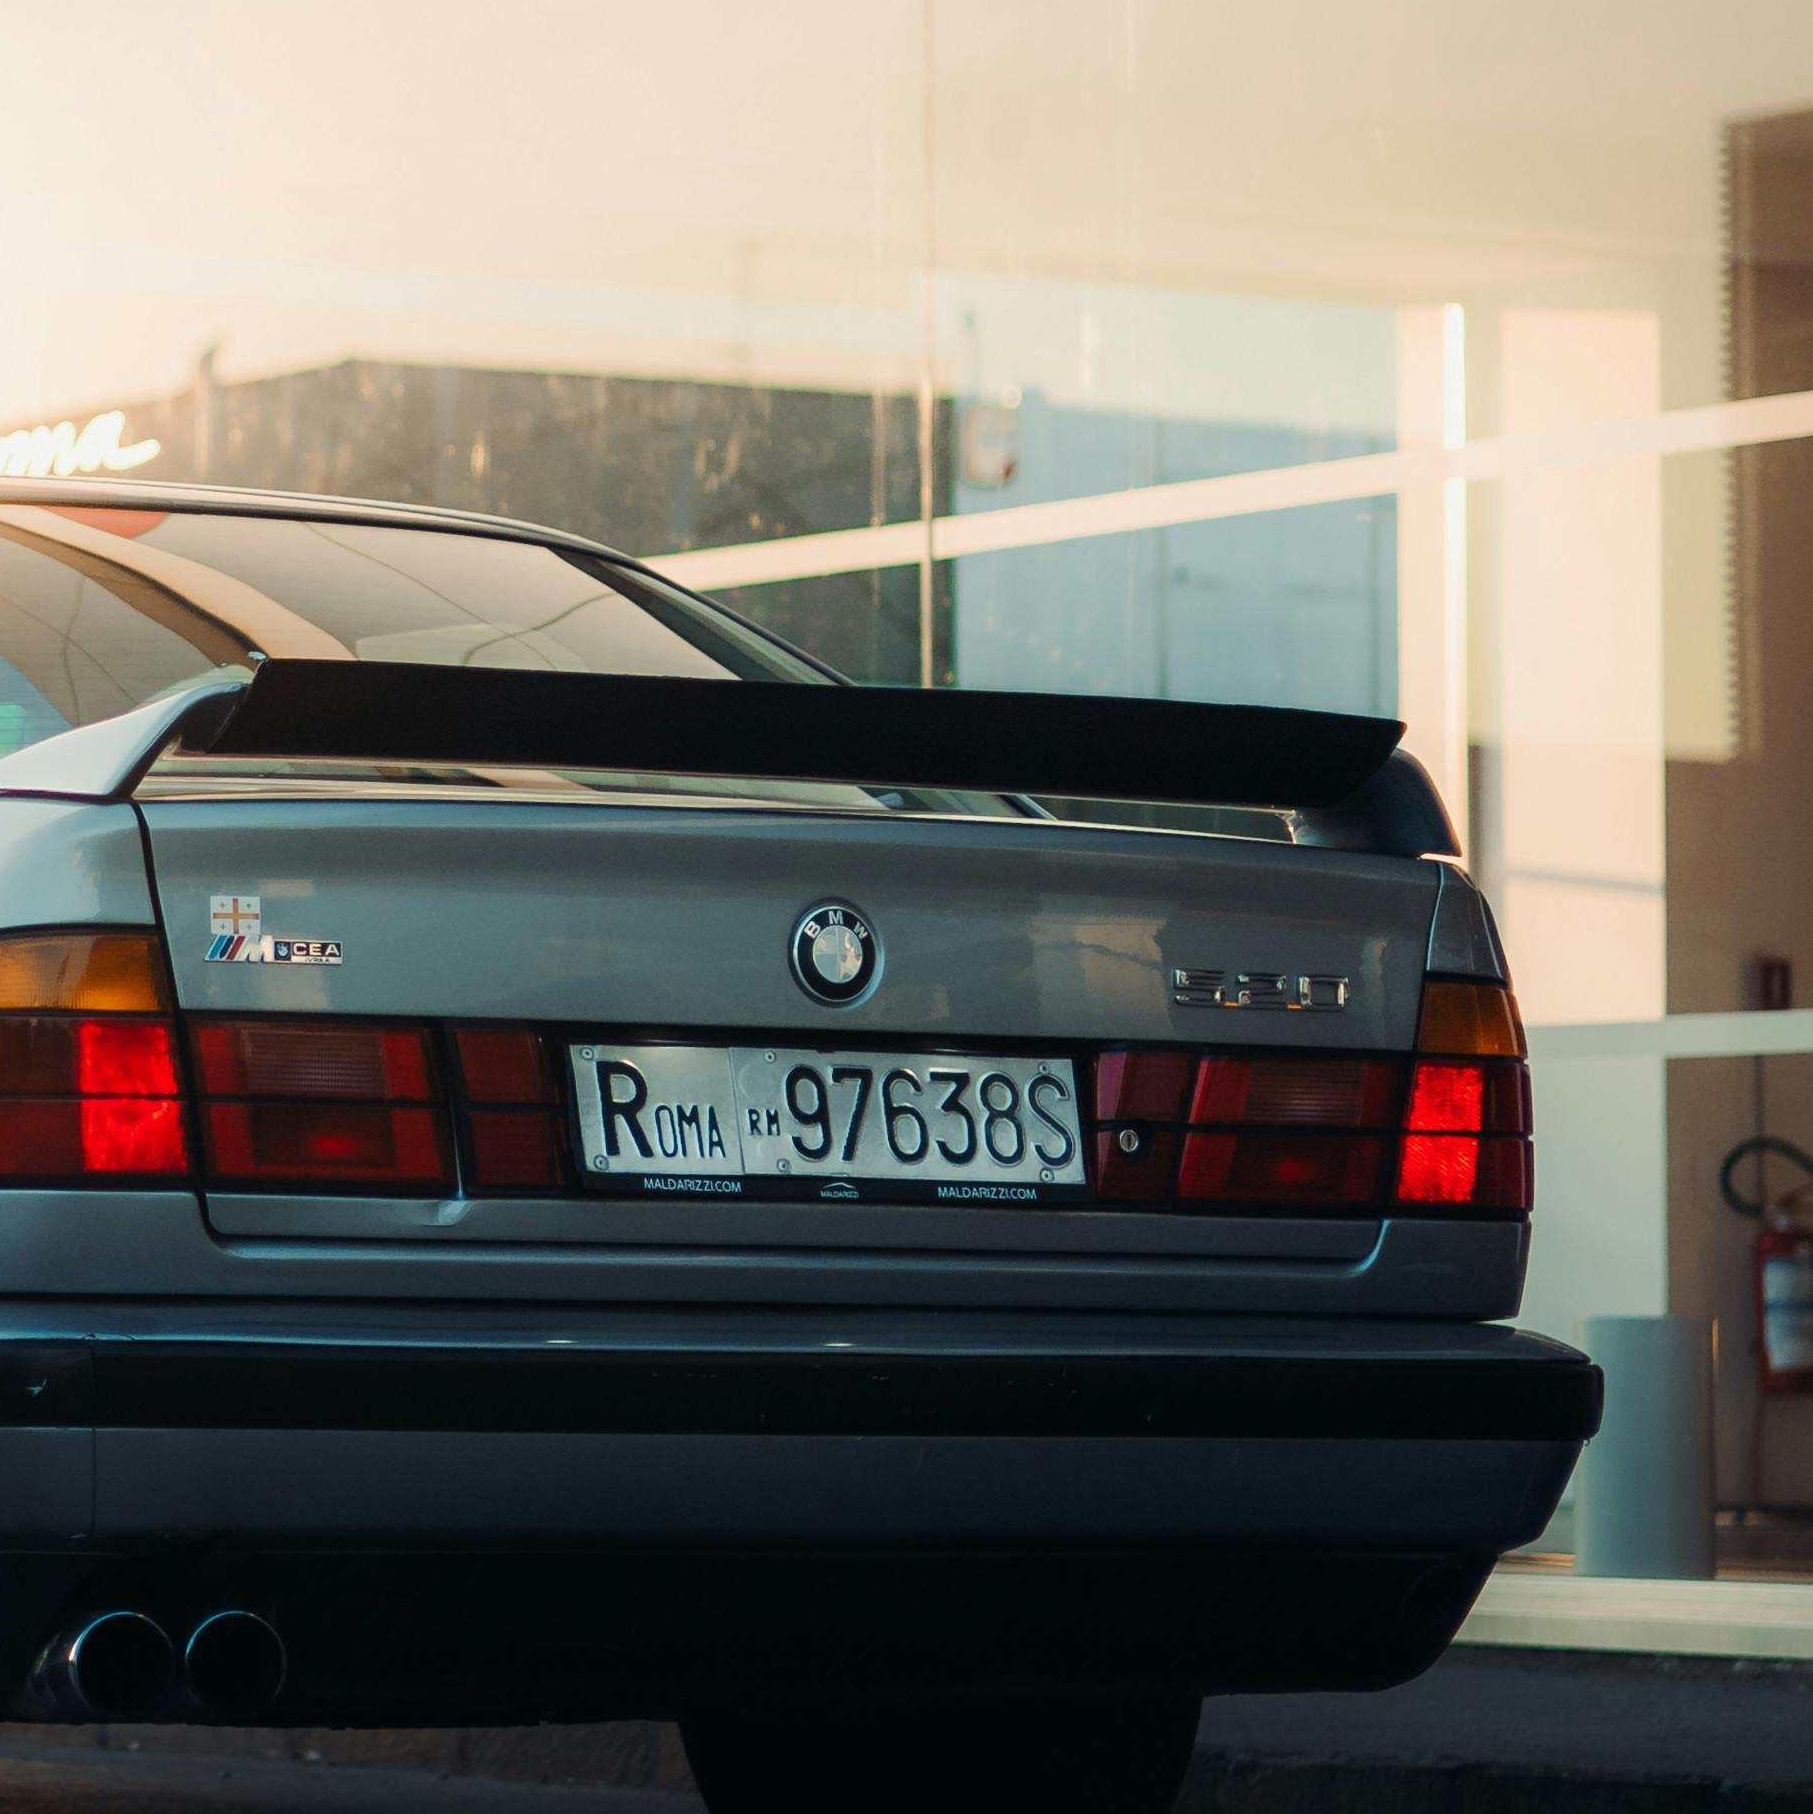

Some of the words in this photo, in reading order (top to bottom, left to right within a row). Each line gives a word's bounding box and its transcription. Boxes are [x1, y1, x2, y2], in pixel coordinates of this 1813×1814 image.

[803, 910, 869, 940] BMW
[293, 942, 340, 956] CEA
[595, 1060, 727, 1158] ROMA
[747, 1107, 782, 1136] RM
[785, 1063, 1075, 1168] 97638S
[644, 1177, 742, 1193] MALDARIZZI.COM
[937, 1186, 1037, 1201] MALDARIZZI.COM
